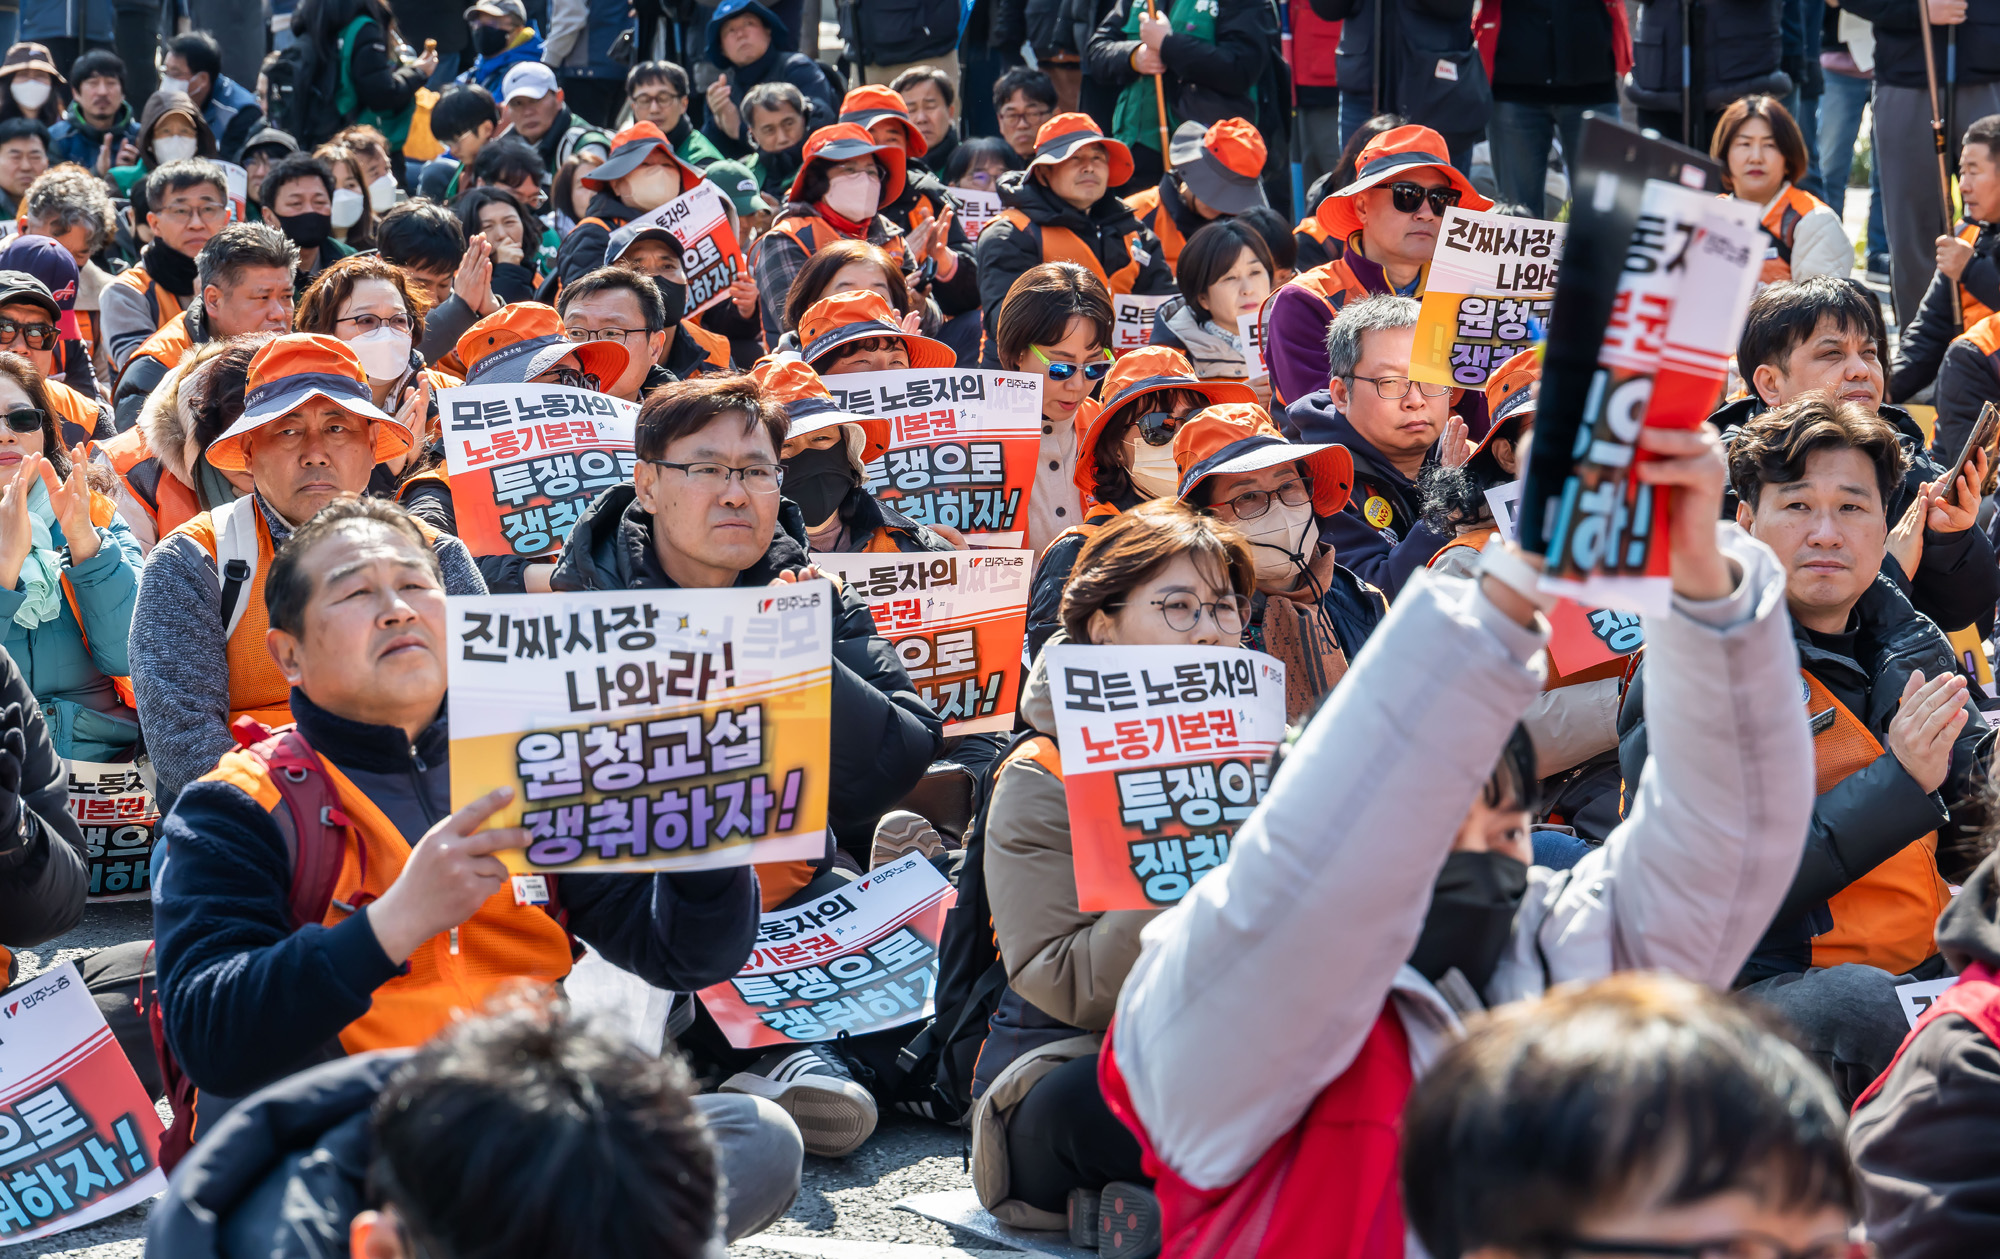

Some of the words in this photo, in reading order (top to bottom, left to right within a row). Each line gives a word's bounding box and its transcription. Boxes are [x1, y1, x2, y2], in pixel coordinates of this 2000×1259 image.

[1445, 216, 1556, 258] 진짜사장
[880, 374, 986, 413] 노동자의
[1006, 377, 1037, 390] 민주노총
[451, 399, 513, 432] 모든
[514, 393, 619, 422] 노동자의
[463, 420, 600, 467] 노동기본권
[887, 487, 1022, 532] 취하자!
[984, 556, 1024, 568] 민주노총
[776, 592, 821, 612] 민주노총
[461, 603, 660, 664] 진짜사장
[565, 641, 736, 713] 나와라!
[1064, 666, 1139, 713] 모든
[1140, 658, 1258, 707] 노동자의
[515, 703, 764, 802] 원청교섭
[1080, 708, 1240, 765] 노동기본권
[522, 767, 805, 867] 쟁취하자!
[872, 859, 917, 885] 민주노총
[756, 893, 859, 944] 동자의
[731, 926, 935, 1008] 투쟁으로
[21, 974, 71, 1010] 민주노총
